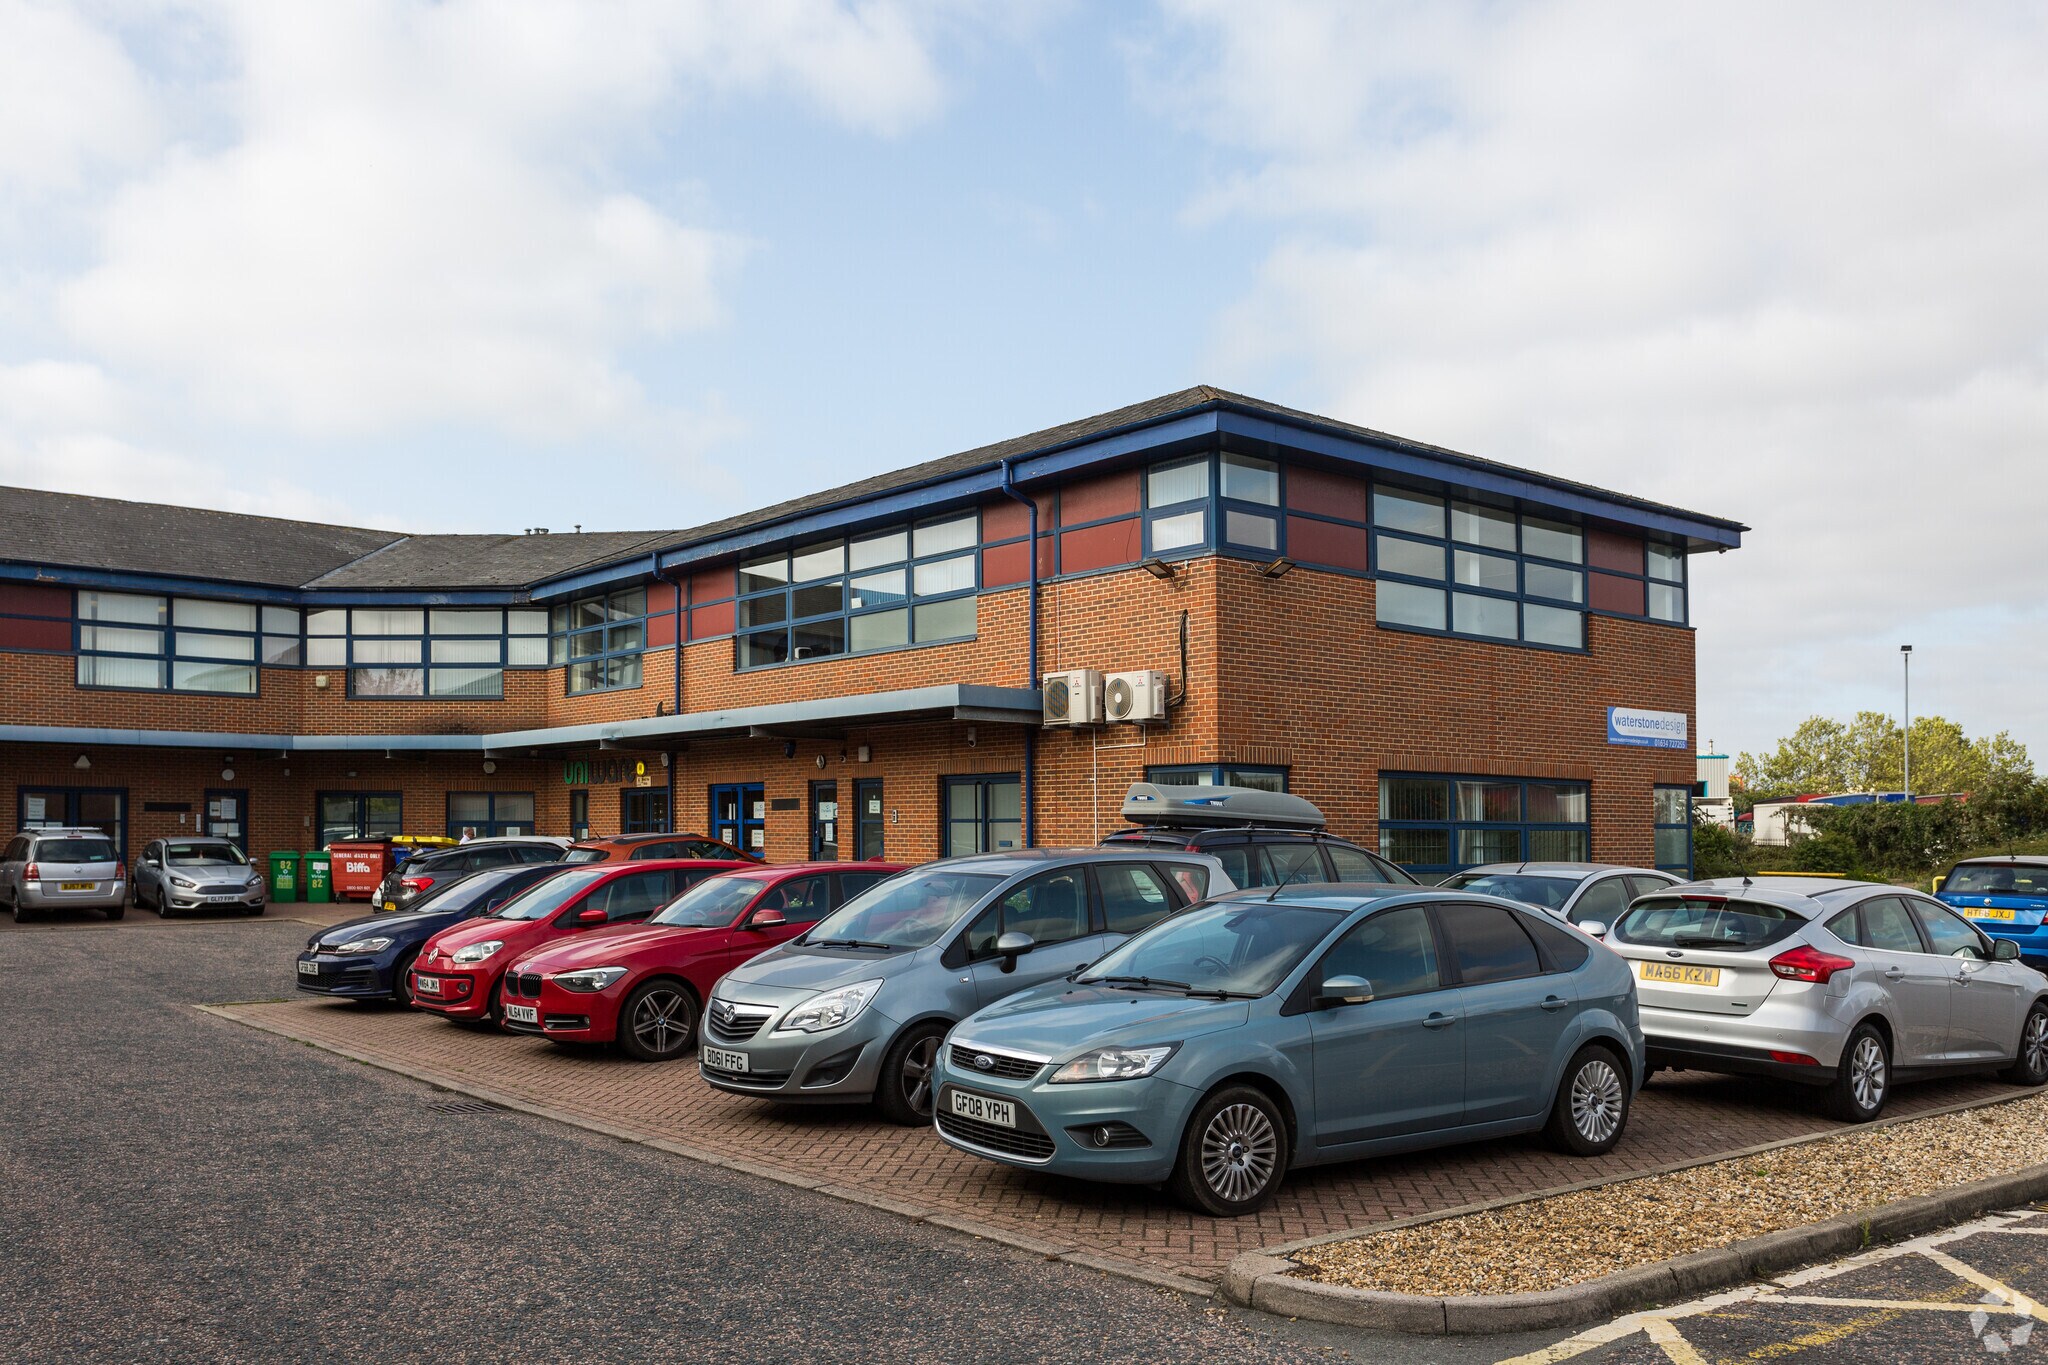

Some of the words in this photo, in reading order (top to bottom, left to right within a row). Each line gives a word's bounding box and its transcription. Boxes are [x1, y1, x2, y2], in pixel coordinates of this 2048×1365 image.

[1614, 714, 1686, 734] waterstonedesign
[1654, 739, 1668, 748] 01634
[280, 860, 292, 870] 82
[346, 862, 370, 872] Biffa
[312, 879, 323, 888] 82
[1966, 908, 1990, 918] HT66
[1992, 909, 2011, 919] JXJ
[1645, 963, 1681, 980] MA66
[1684, 967, 1713, 983] KZW
[707, 1049, 724, 1067] BD61
[724, 1053, 743, 1071] FFG
[955, 1093, 983, 1117] GF08
[985, 1100, 1010, 1123] YPH
